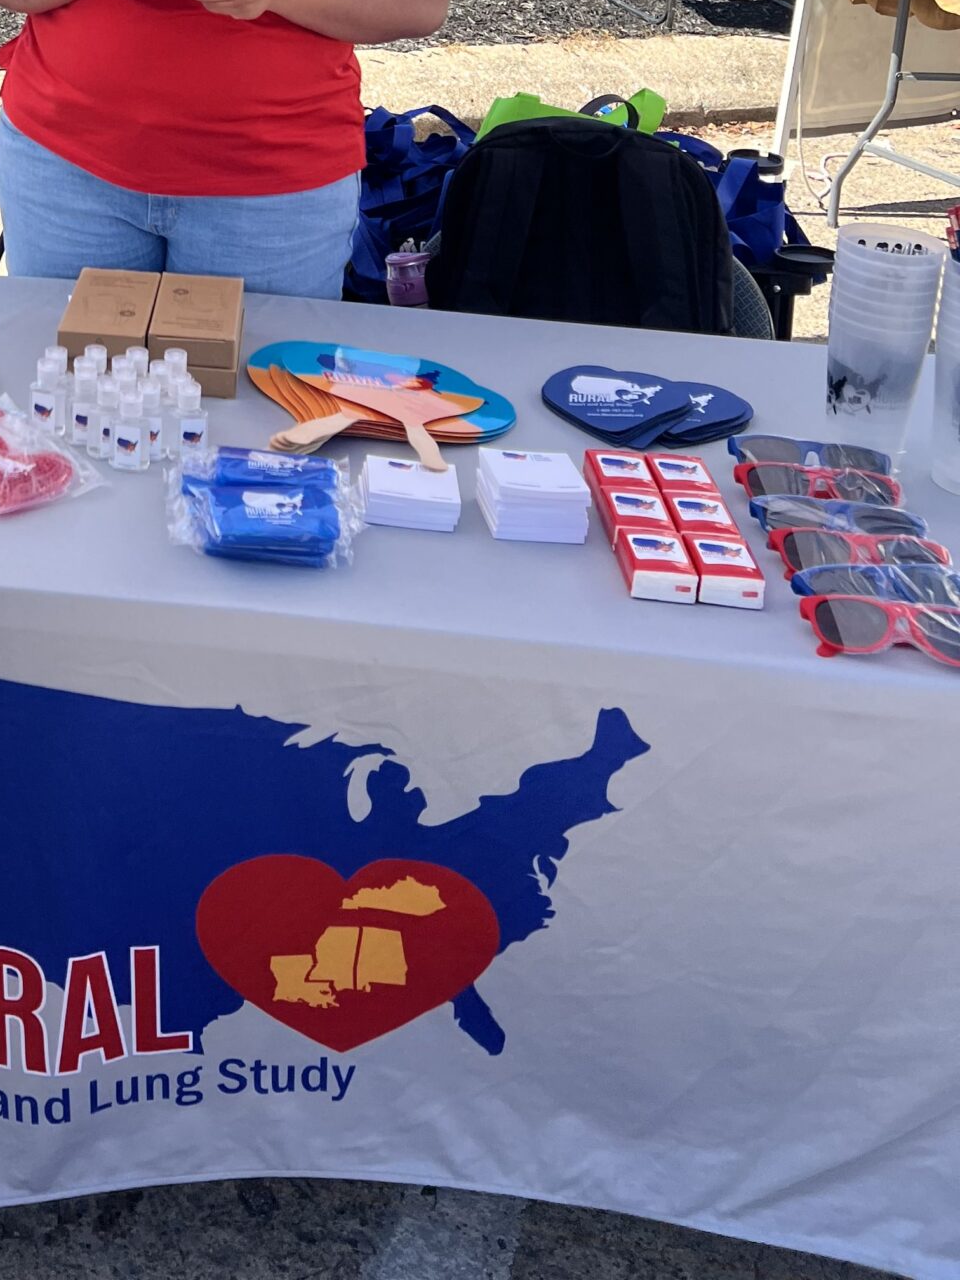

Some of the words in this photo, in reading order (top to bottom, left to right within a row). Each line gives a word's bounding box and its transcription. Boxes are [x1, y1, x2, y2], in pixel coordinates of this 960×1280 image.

[569, 393, 614, 403] RURAL
[89, 1065, 203, 1115] Lung
[217, 1056, 357, 1101] Study
